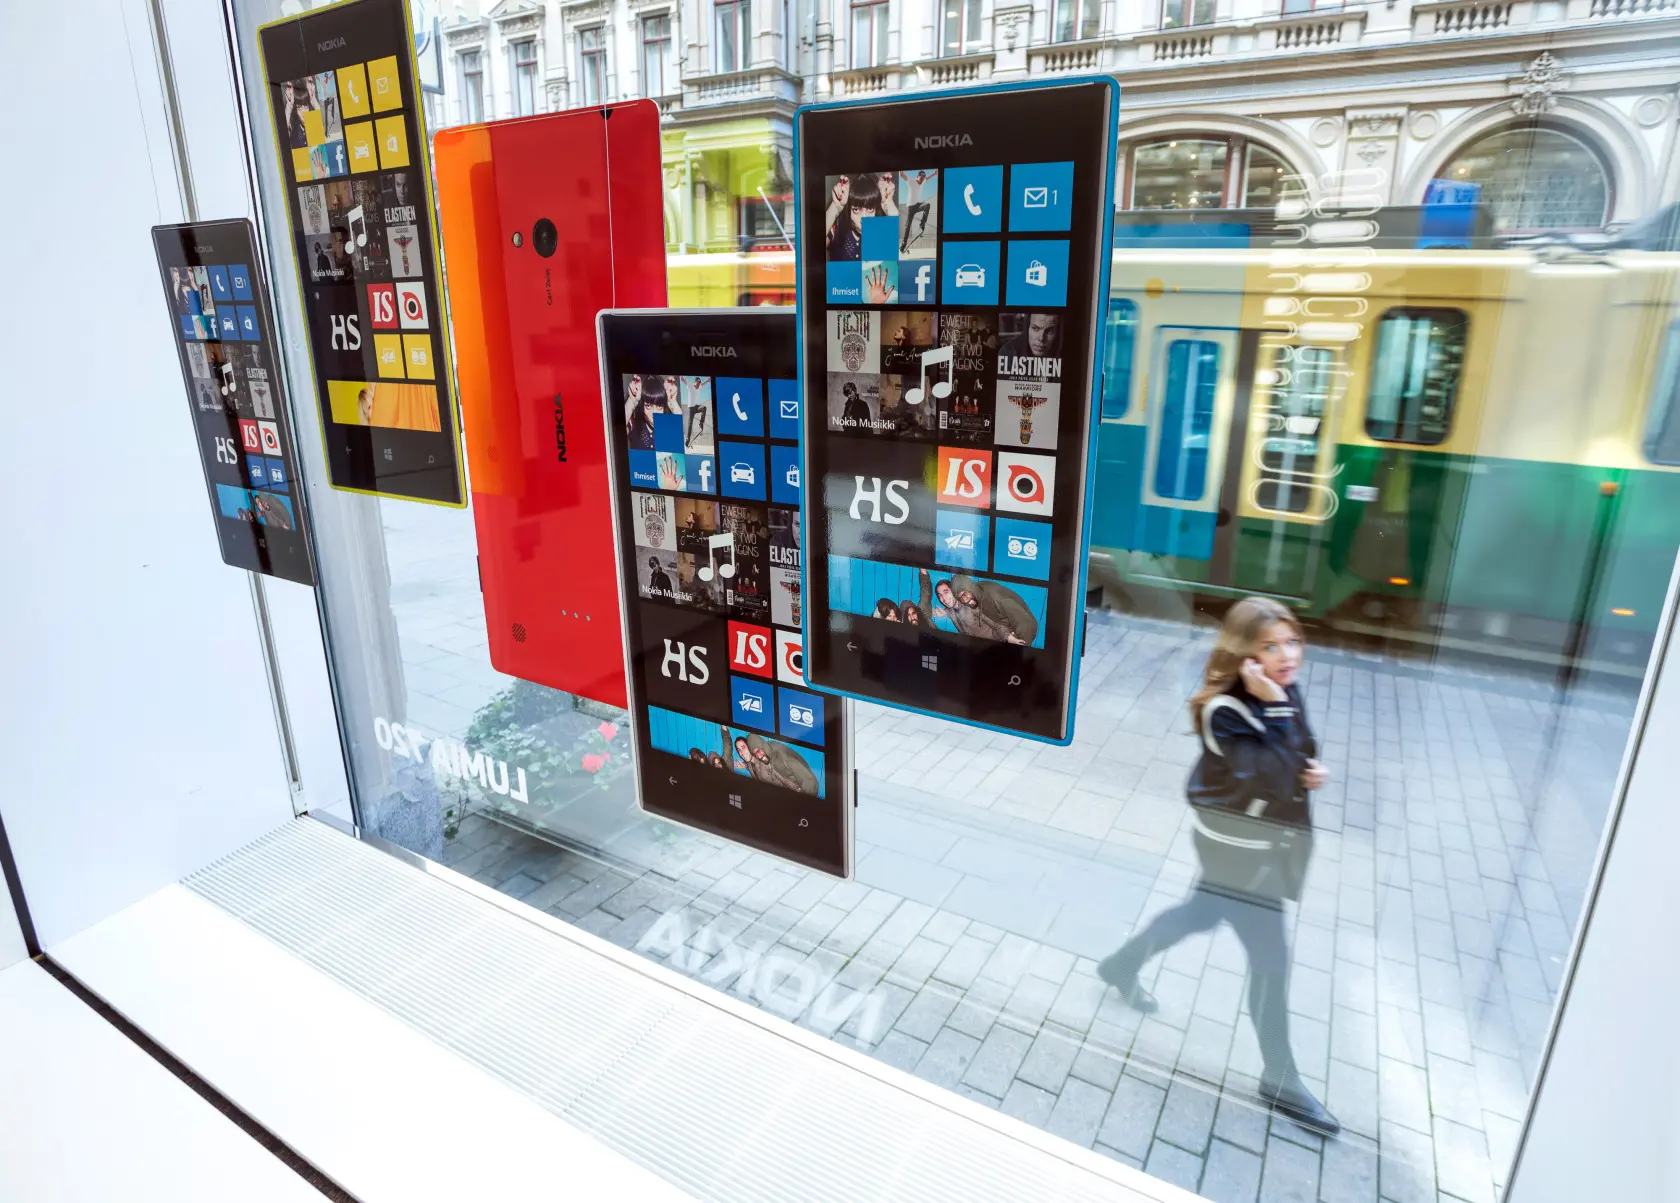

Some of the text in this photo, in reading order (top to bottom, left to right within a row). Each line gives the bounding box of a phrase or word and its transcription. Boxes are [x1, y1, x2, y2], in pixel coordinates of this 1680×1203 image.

[317, 36, 347, 52] NOKIA
[914, 133, 973, 150] NOKIA
[1052, 189, 1058, 205] 1
[832, 286, 858, 296] Ihmiset
[372, 291, 393, 322] IS
[940, 314, 972, 327] EWERT
[330, 314, 362, 350] HS
[690, 346, 738, 358] NOKIA
[997, 356, 1062, 378] ELASTINEN
[554, 393, 567, 462] NOKIA
[832, 416, 895, 430] Nokia Musiikki
[243, 424, 258, 448] IS
[215, 436, 238, 464] HS
[634, 472, 656, 482] Ihmiset
[942, 457, 986, 498] IS
[849, 475, 910, 524] HS
[642, 585, 662, 596] Nokia
[734, 630, 768, 668] IS
[661, 638, 710, 684] HS
